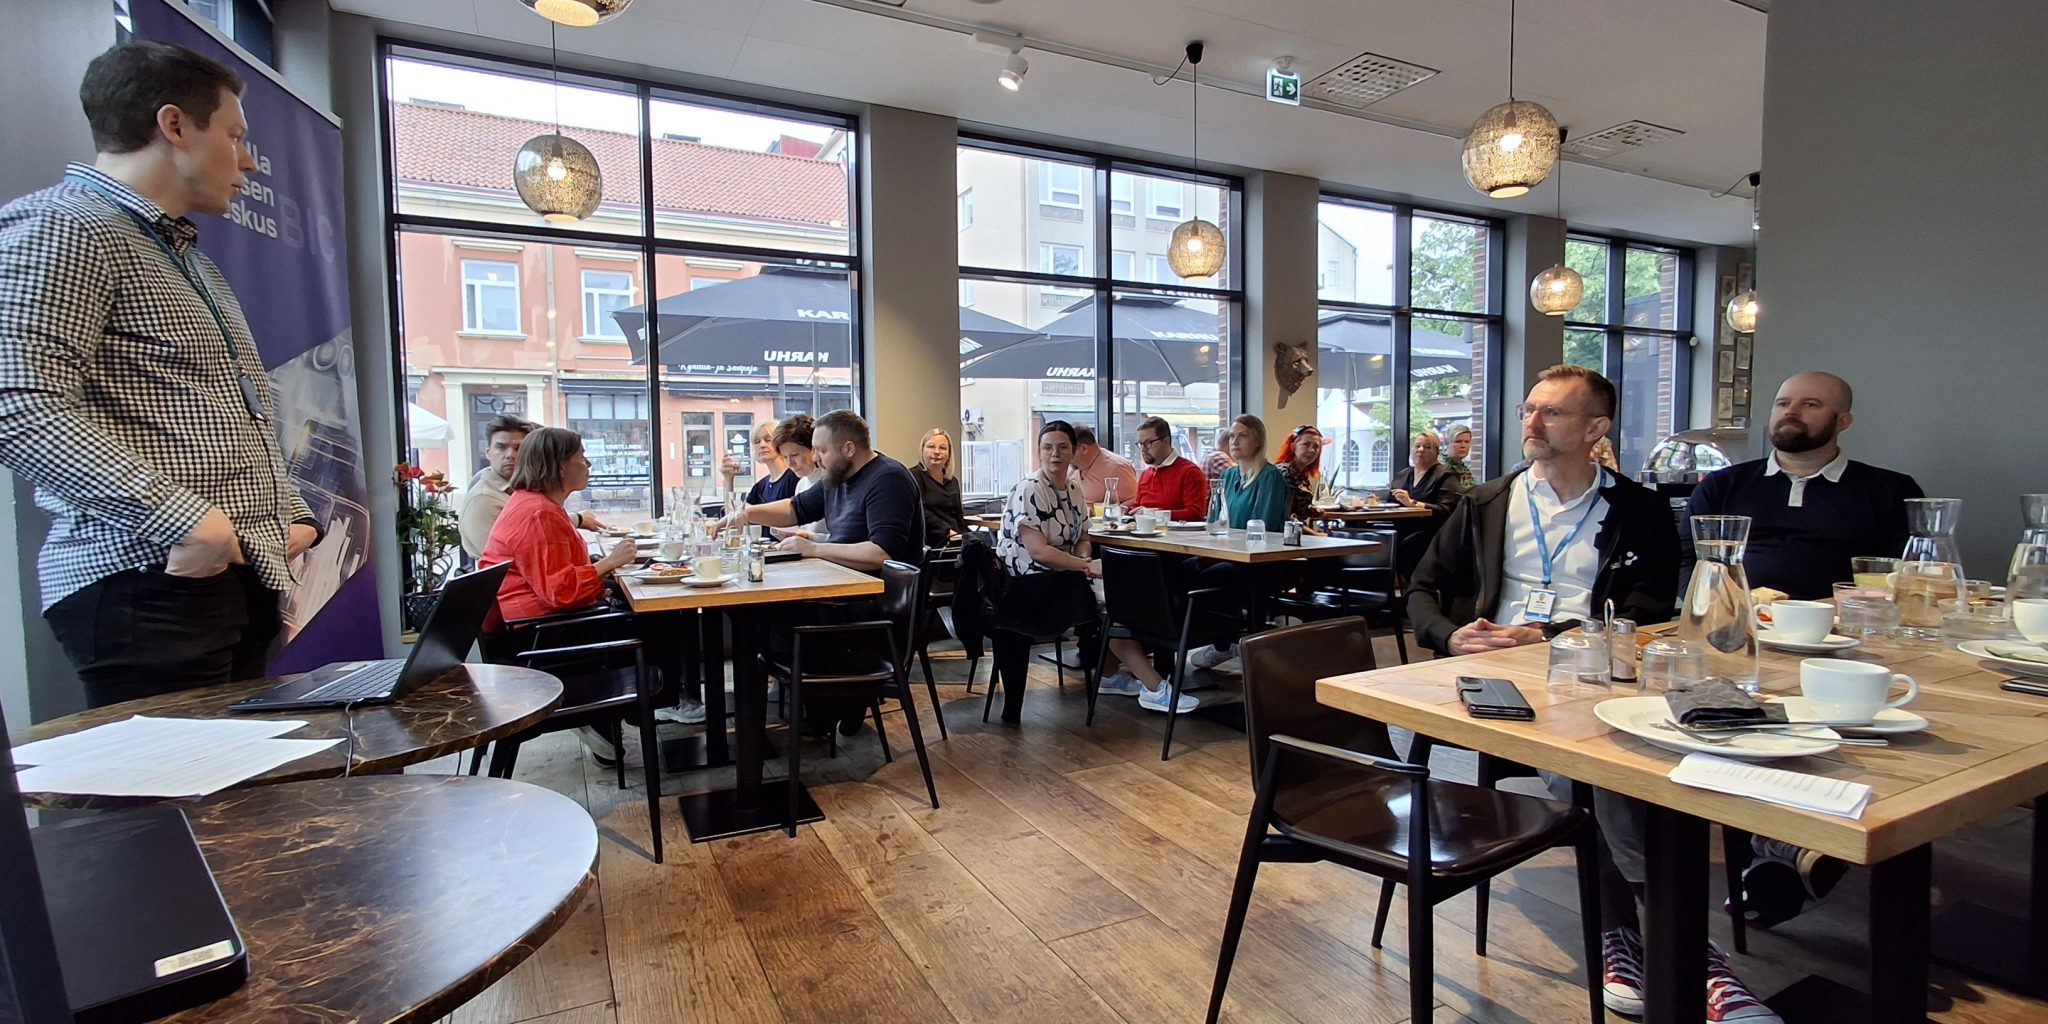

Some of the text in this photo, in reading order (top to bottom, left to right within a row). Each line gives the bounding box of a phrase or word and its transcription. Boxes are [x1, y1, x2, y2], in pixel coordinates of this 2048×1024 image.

[240, 179, 275, 208] sen
[222, 200, 278, 239] skus
[797, 308, 849, 320] KAR
